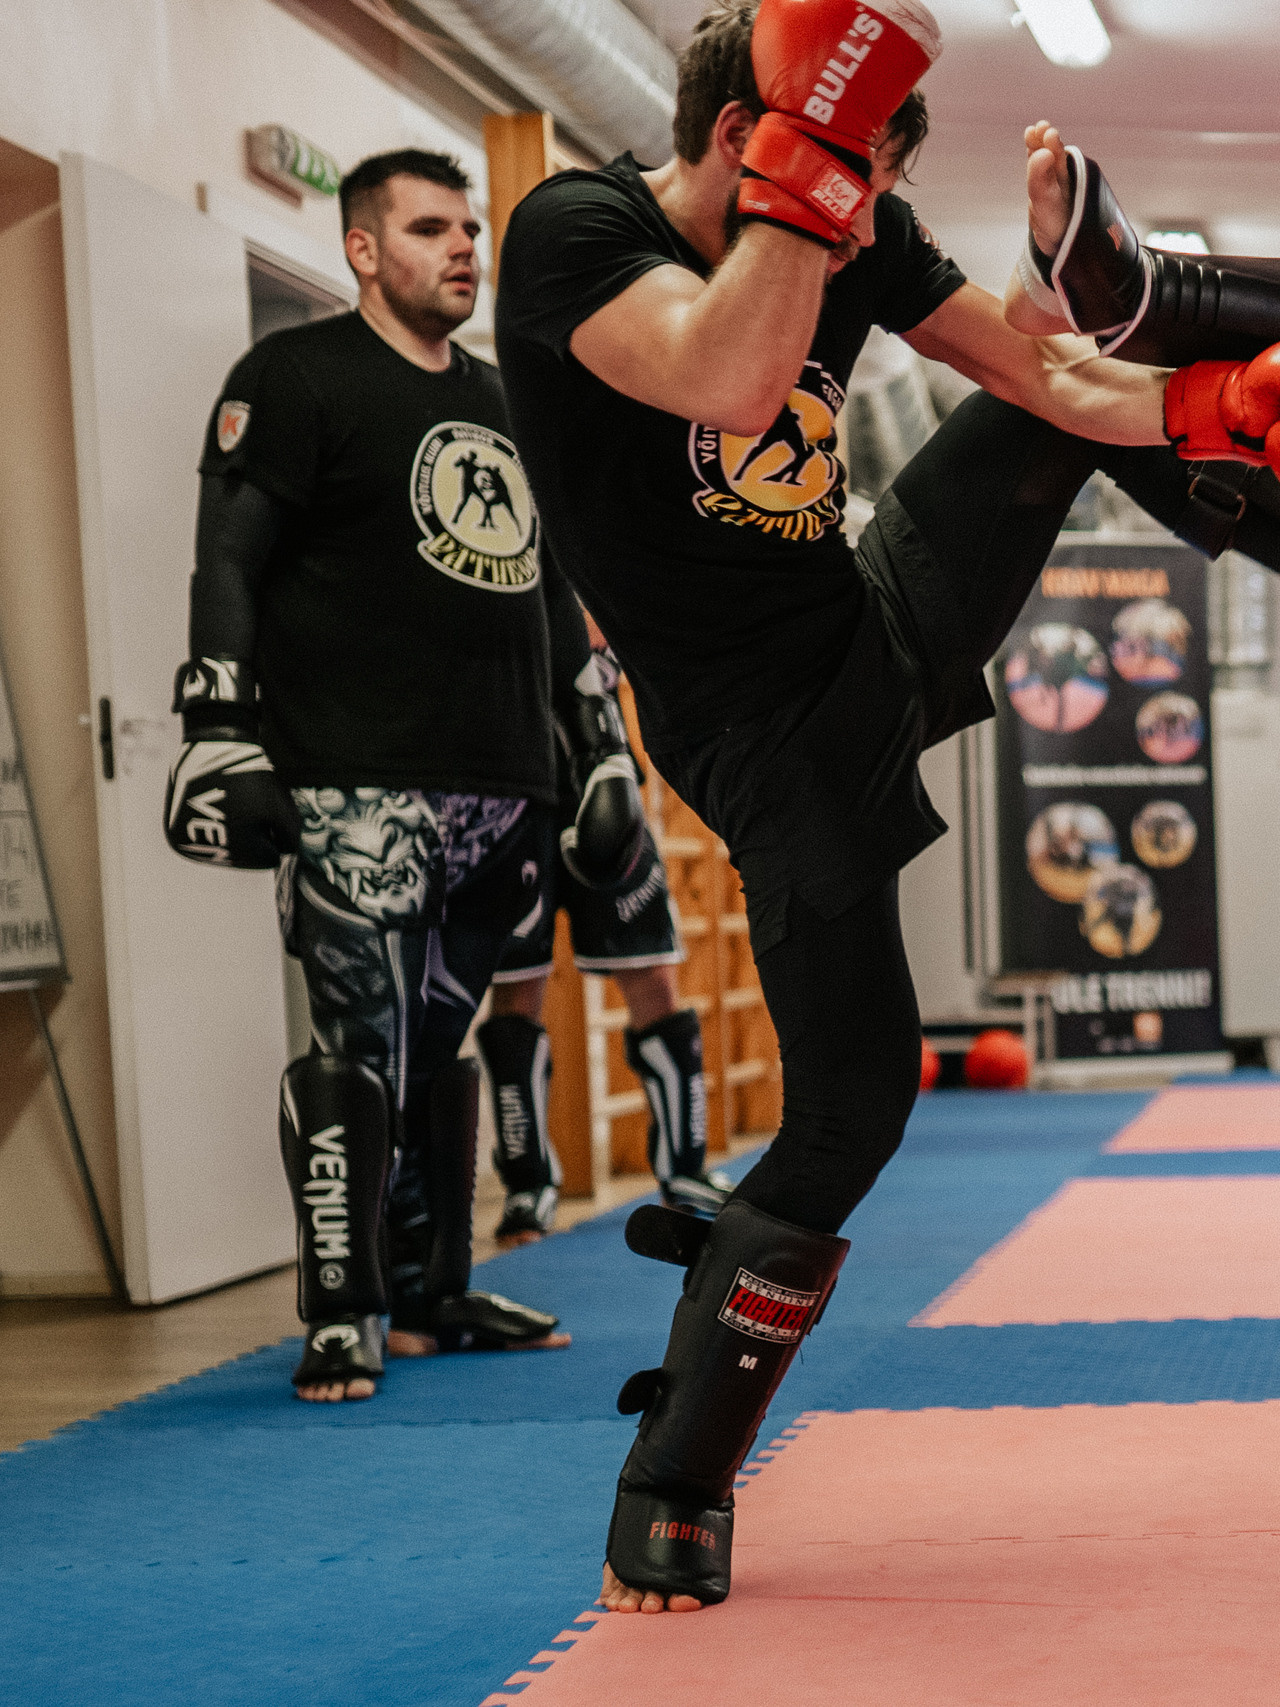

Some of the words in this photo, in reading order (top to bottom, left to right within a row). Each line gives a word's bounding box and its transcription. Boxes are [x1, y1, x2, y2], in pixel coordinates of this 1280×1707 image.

[803, 13, 884, 124] BULL'S
[303, 1124, 351, 1260] VENUM
[728, 1286, 810, 1330] FIGHTER
[738, 1354, 759, 1371] M
[648, 1520, 717, 1552] FIGHTER
